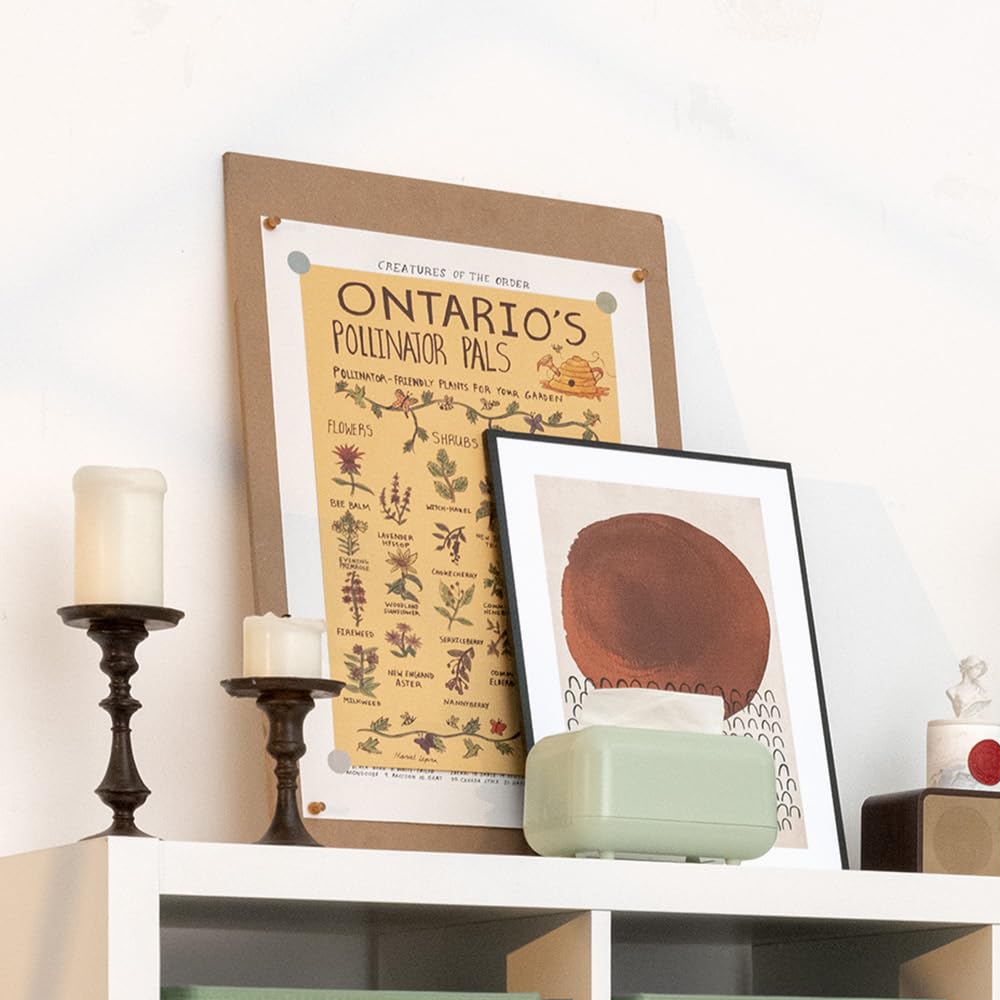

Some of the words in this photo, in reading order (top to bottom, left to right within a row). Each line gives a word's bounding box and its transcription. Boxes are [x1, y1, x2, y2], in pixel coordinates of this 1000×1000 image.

[378, 260, 447, 278] CREATURES
[453, 270, 465, 280] OF
[469, 272, 490, 283] THE
[496, 276, 530, 290] ORDER
[337, 281, 587, 346] ONTARIO'S
[332, 319, 447, 366] POLLINATOR
[462, 336, 512, 373] PALS
[439, 379, 469, 391] PLANTS
[473, 383, 491, 394] FOR
[496, 386, 519, 398] YOUR
[525, 391, 563, 402] GARDEN
[327, 419, 373, 438] FLOWERS
[432, 431, 479, 449] SHRUBS
[329, 499, 345, 508] BEE
[348, 501, 371, 512] BALM
[377, 531, 415, 541] LAVENDER
[384, 601, 419, 610] WOODLAND
[336, 627, 375, 638] FIREWEED
[387, 669, 403, 678] NEW
[405, 670, 435, 680] ENGLAND
[395, 679, 423, 689] ASTER
[343, 697, 382, 707] MILKWEED
[443, 699, 490, 710] NANNYBERRY
